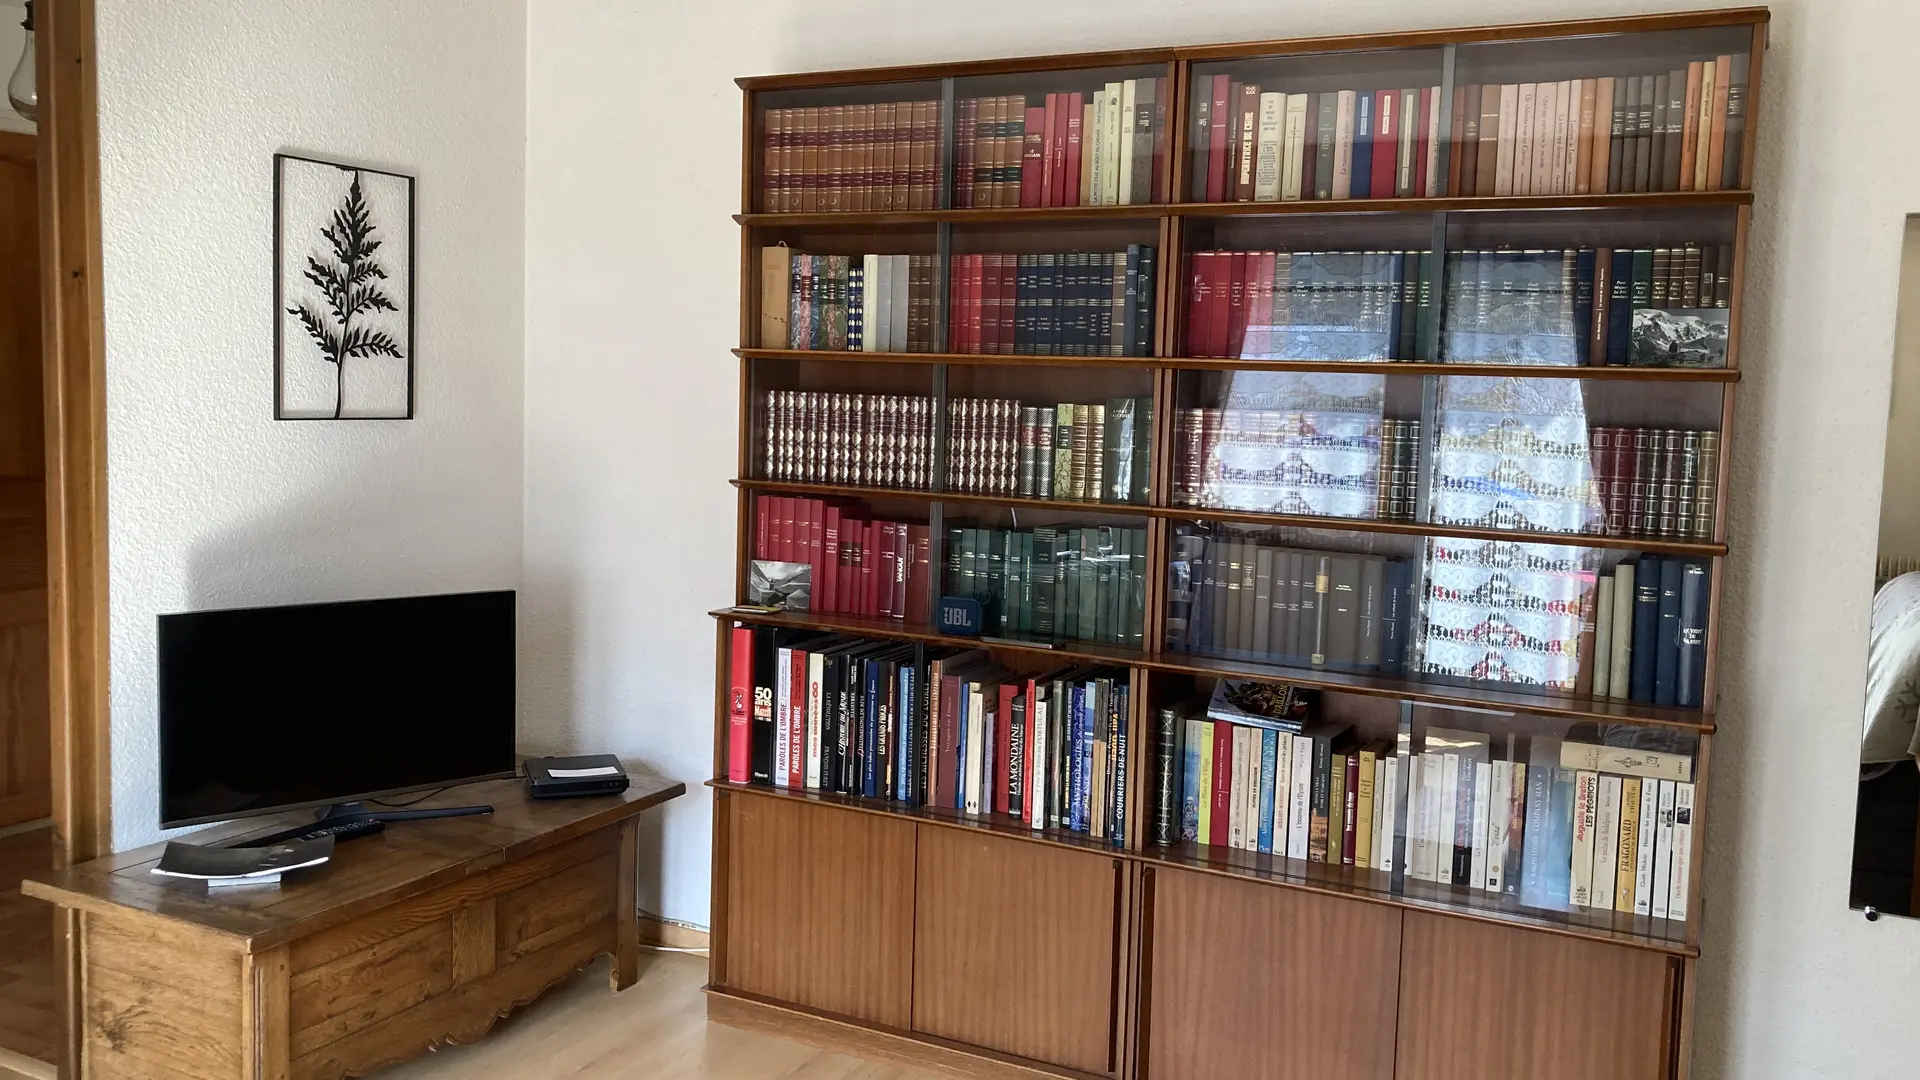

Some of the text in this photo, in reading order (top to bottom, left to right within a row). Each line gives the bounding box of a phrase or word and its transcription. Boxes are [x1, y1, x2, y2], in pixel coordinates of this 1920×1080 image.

[1242, 112, 1254, 140] DE CHINE
[944, 607, 972, 626] JBL
[755, 686, 772, 700] 50
[812, 682, 819, 698] 60
[754, 698, 772, 706] ans
[778, 704, 787, 772] PAROLES DE L'OMBRE
[792, 705, 801, 774] PAROLES DE L'OMBRE
[1118, 732, 1126, 756] NUIT
[878, 745, 886, 755] LES
[1010, 723, 1019, 780] MONDAINE
[1074, 738, 1082, 807] MYTHOLOGIES
[1117, 758, 1126, 769] DE
[1009, 782, 1018, 795] LA
[1116, 770, 1125, 820] COURRIERS
[1296, 782, 1305, 800] l'Élysée
[1585, 777, 1596, 814] PÉGRIOTS
[1202, 800, 1208, 808] La
[1532, 781, 1542, 832] COMPANY MAN
[1576, 776, 1587, 842] Auguste le Breton
[1585, 814, 1594, 828] LES
[1620, 819, 1632, 872] FRAGONARD
[1640, 873, 1648, 888] Claude
